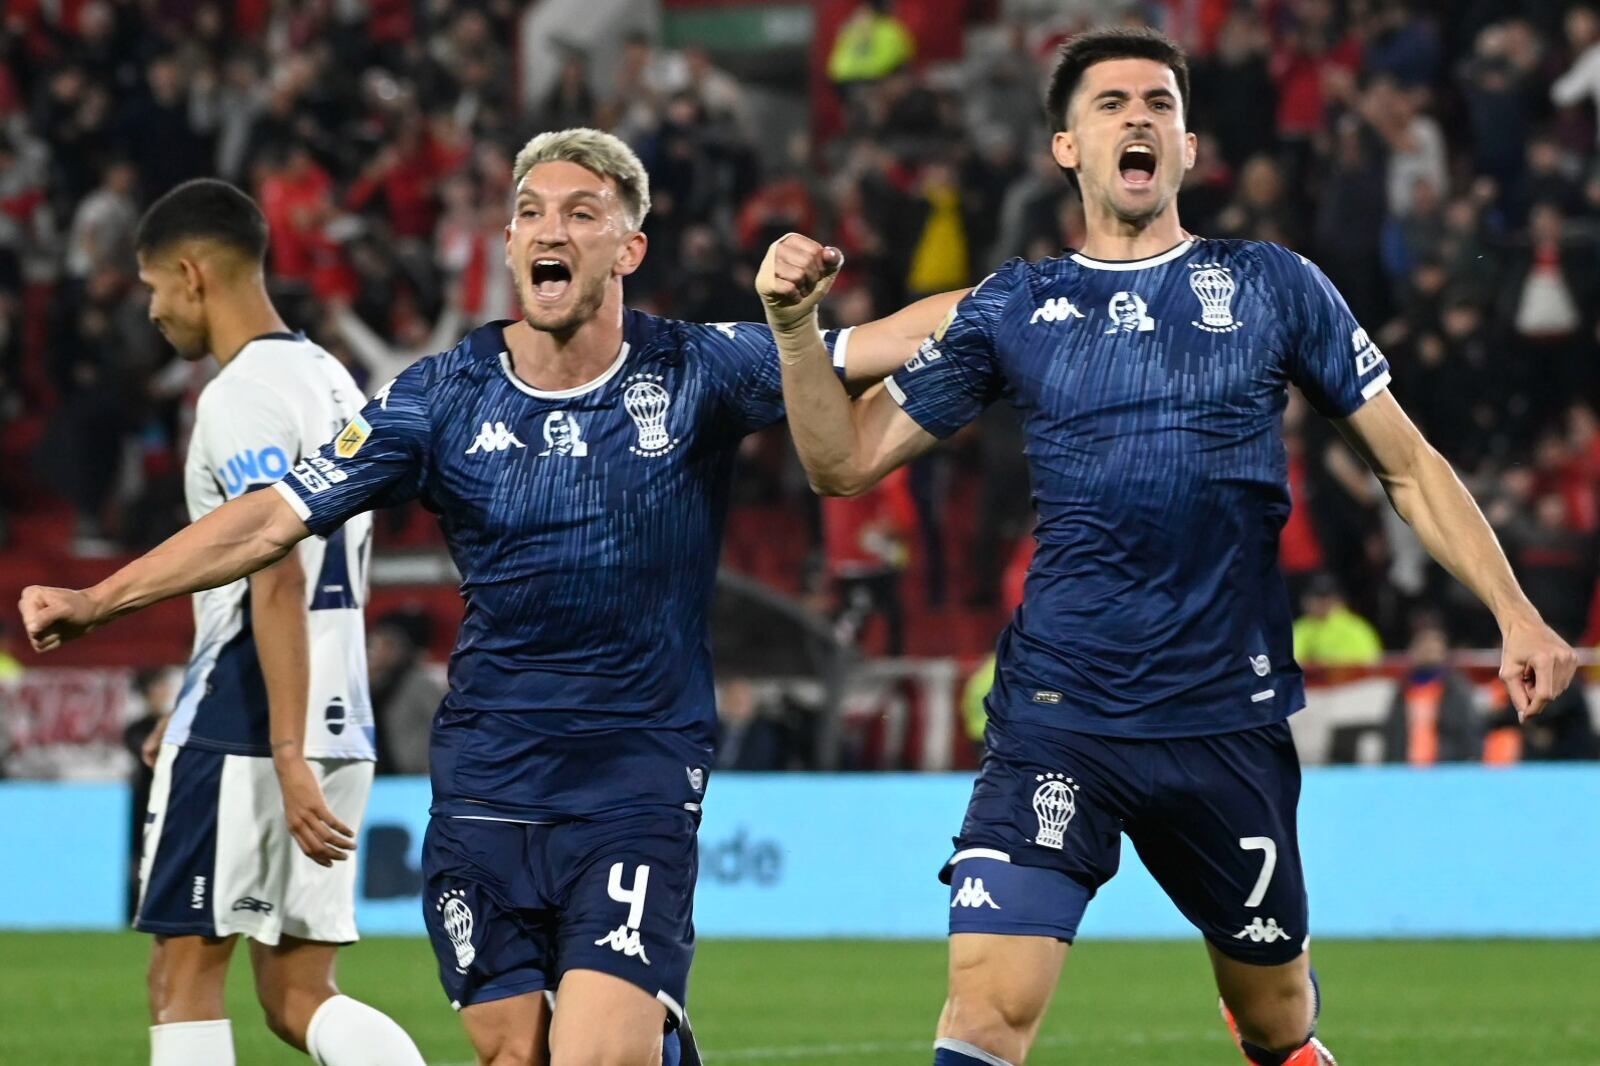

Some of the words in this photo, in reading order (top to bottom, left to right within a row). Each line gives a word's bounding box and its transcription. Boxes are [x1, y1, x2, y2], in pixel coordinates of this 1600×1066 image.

[218, 446, 288, 495] UNO
[191, 875, 206, 909] LYON
[607, 862, 650, 930] 4
[1239, 836, 1277, 907] 7
